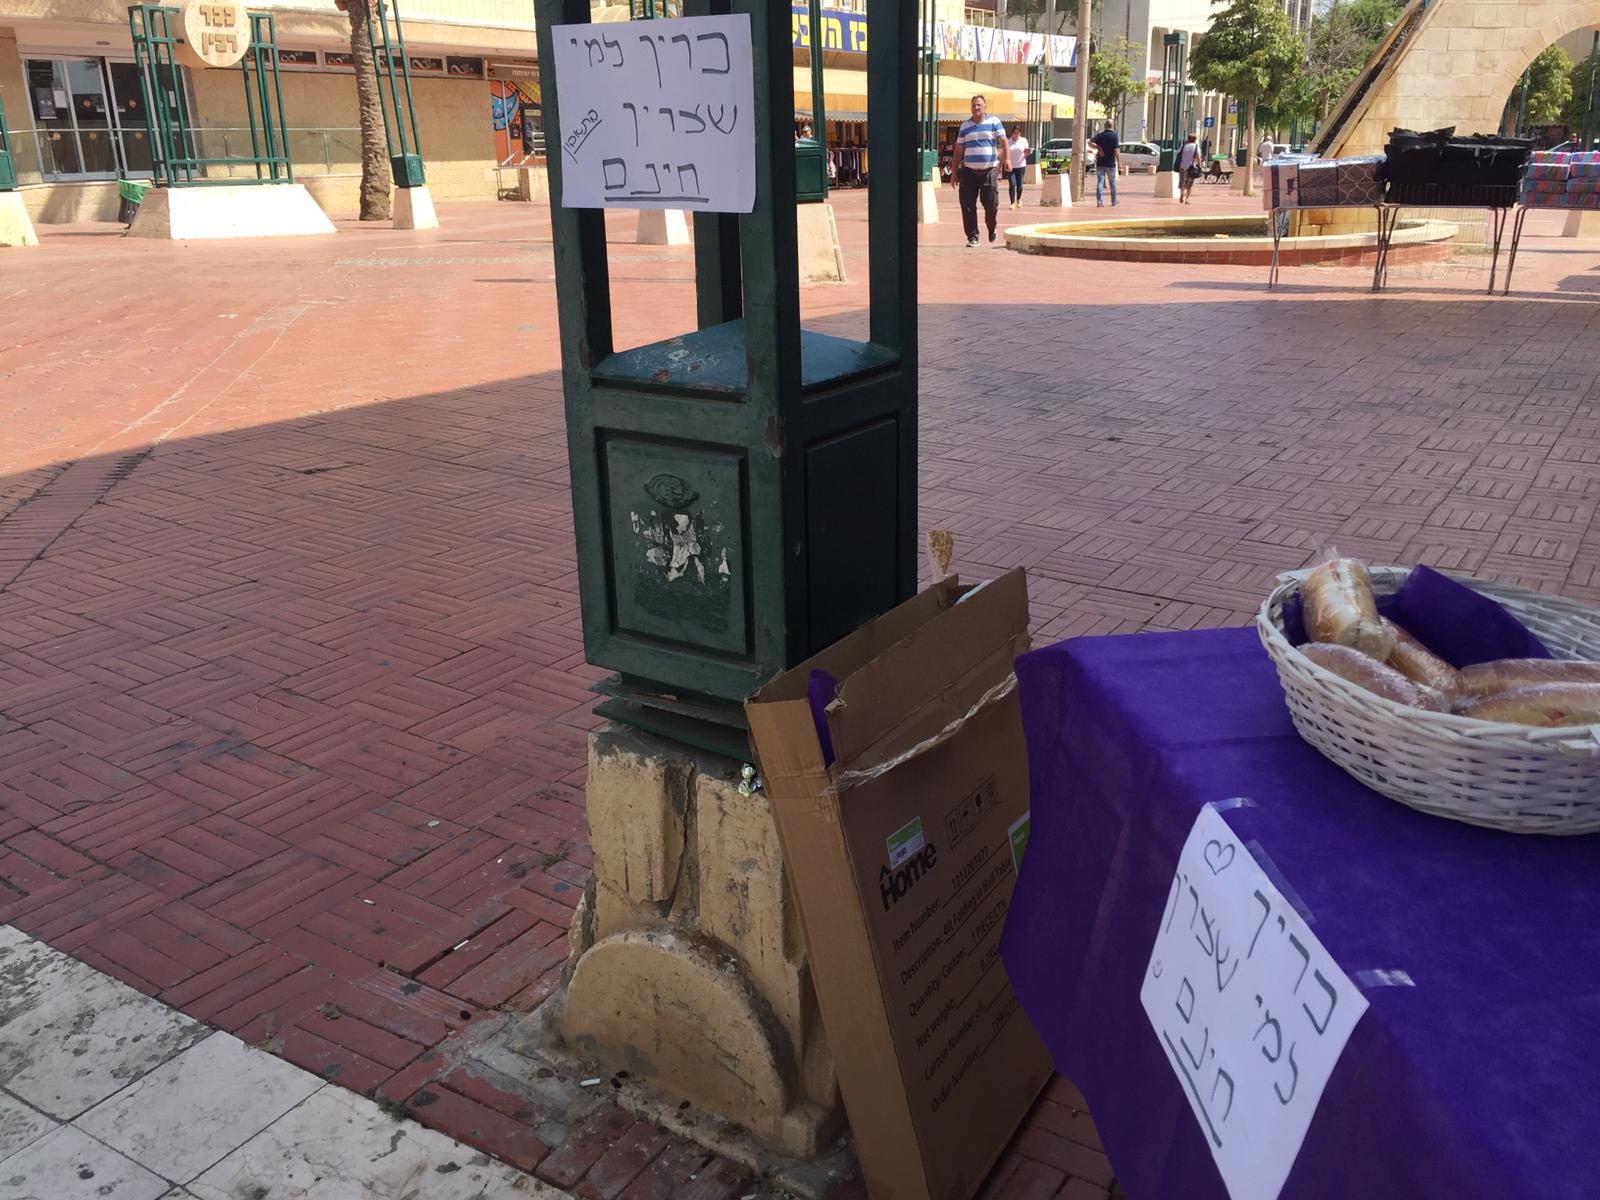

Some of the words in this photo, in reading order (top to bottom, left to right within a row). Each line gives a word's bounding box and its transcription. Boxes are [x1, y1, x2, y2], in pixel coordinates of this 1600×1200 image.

[201, 32, 238, 56] רבין
[570, 32, 624, 68] למי
[639, 32, 731, 89] כריך
[622, 102, 738, 148] שצריך
[602, 157, 701, 196] חינם
[893, 930, 911, 953] Item
[900, 937, 943, 985] Description:
[943, 920, 953, 936] 4ft
[953, 893, 976, 924] Folding
[1165, 873, 1240, 992] שצריך
[1247, 888, 1338, 1036] כריך
[917, 1027, 930, 1050] Net
[925, 1048, 948, 1081] Carton
[948, 1014, 974, 1049] Number
[1175, 976, 1236, 1121] חינם
[1252, 993, 1300, 1106] למי
